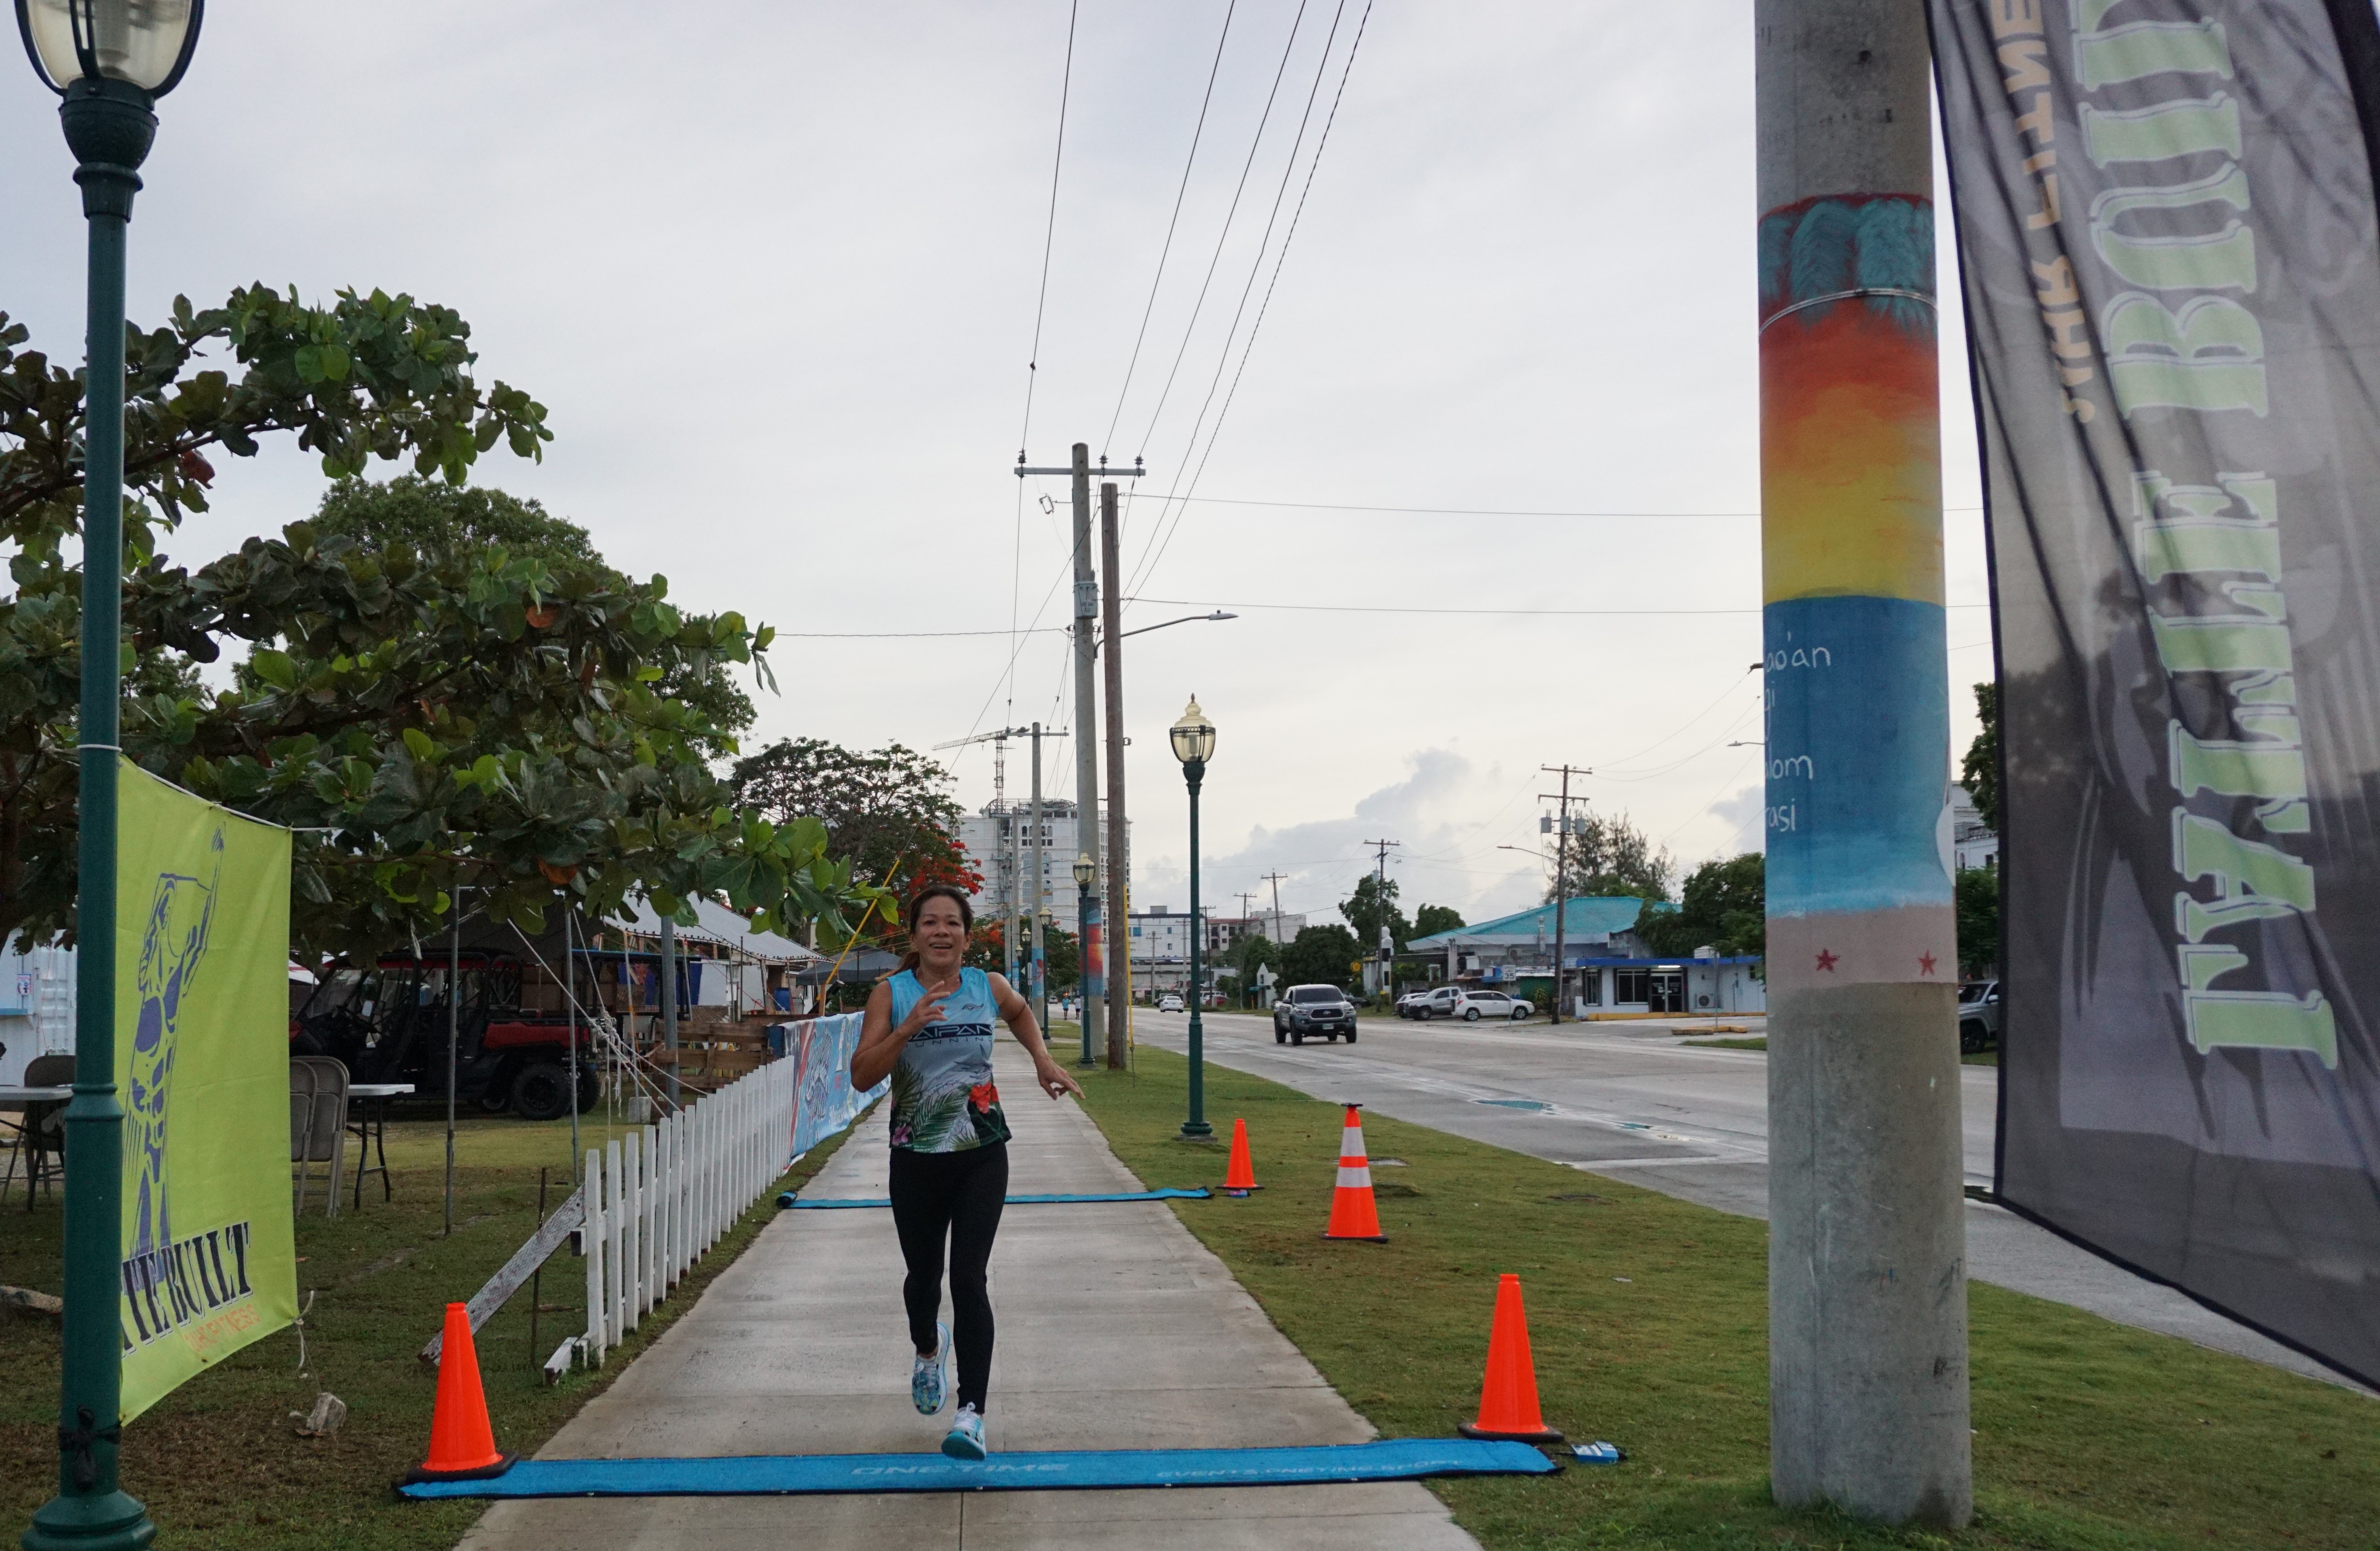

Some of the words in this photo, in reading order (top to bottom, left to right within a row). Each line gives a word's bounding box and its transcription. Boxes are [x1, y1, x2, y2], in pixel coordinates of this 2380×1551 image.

[908, 1025, 992, 1040] AIPAN
[906, 1036, 992, 1048] UNNING
[161, 1221, 253, 1328] BUILT
